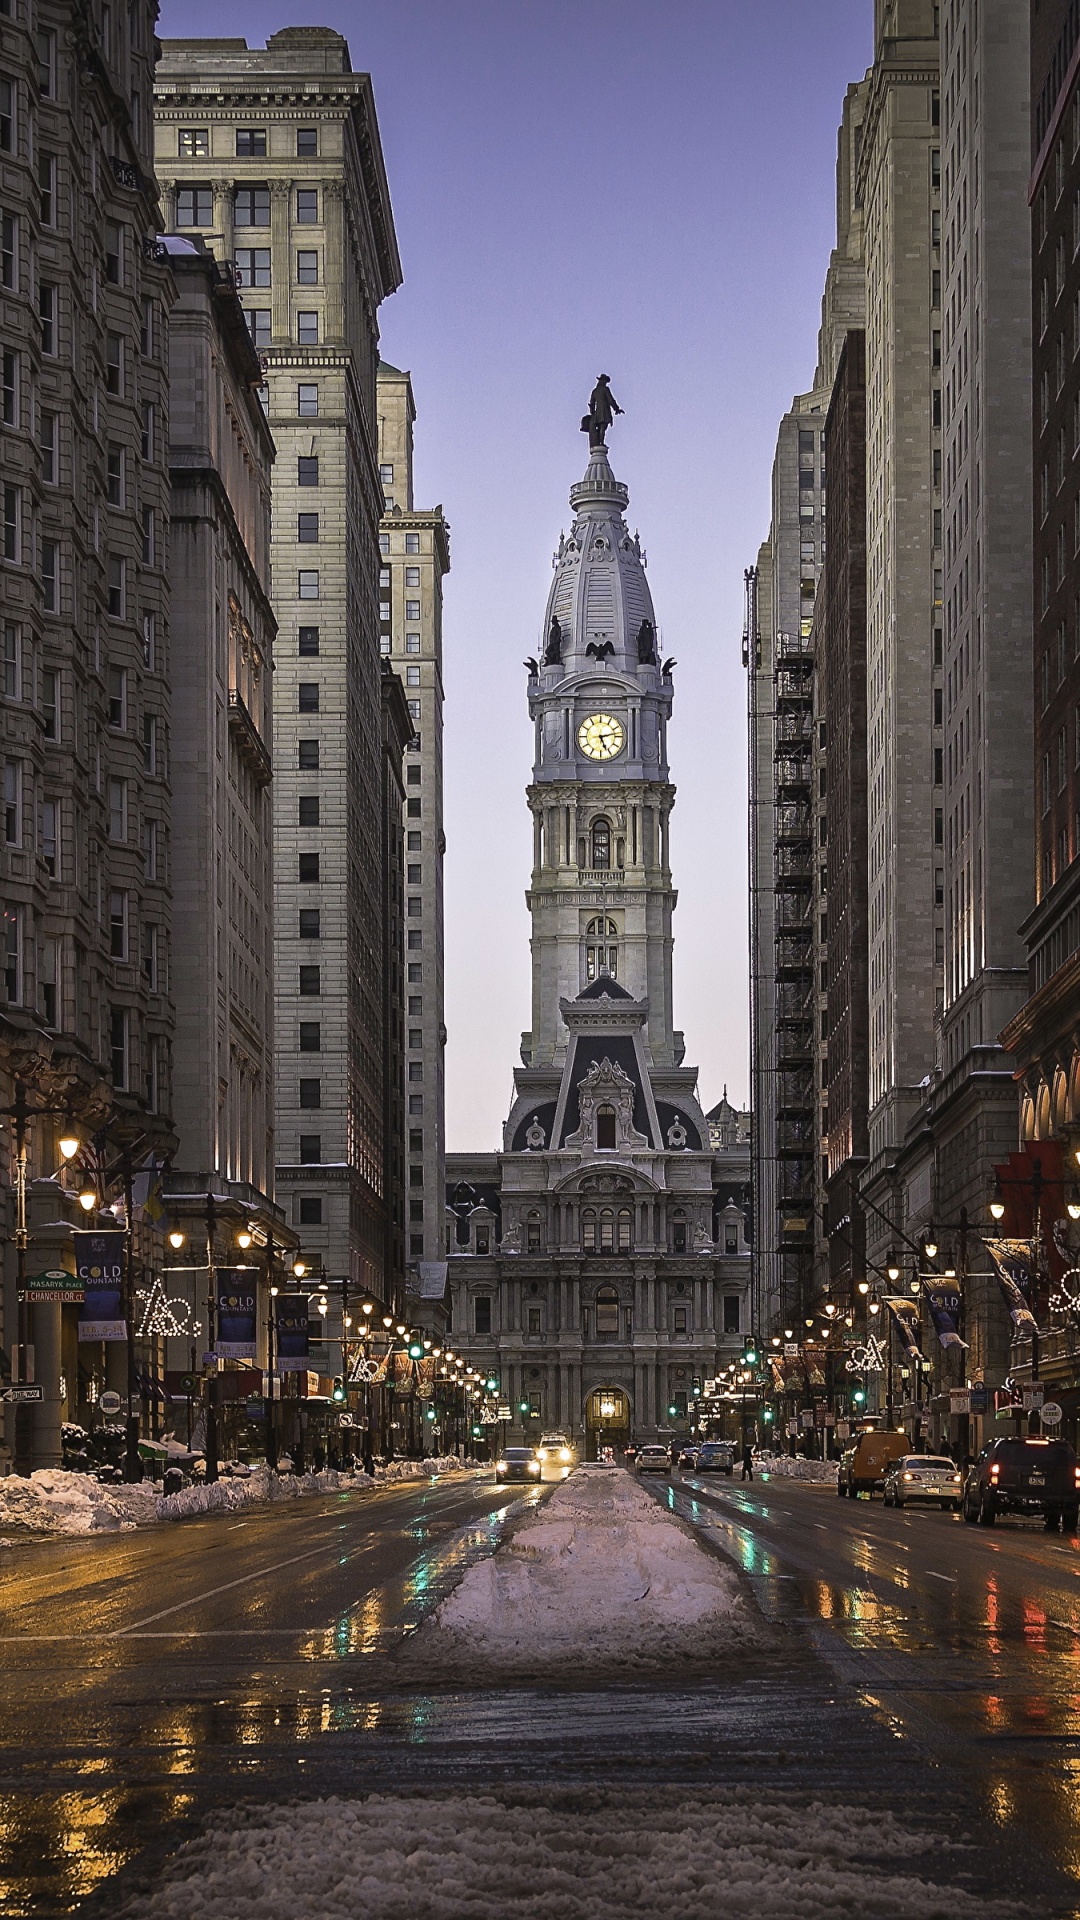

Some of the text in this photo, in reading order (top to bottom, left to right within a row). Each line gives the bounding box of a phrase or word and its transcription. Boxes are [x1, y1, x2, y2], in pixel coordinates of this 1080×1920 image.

[80, 1266, 121, 1278] COLD
[86, 1277, 121, 1285] OUNTAIN
[31, 1292, 74, 1301] CHANCELLOR
[220, 1296, 254, 1307] COLD
[279, 1318, 307, 1327] COLD
